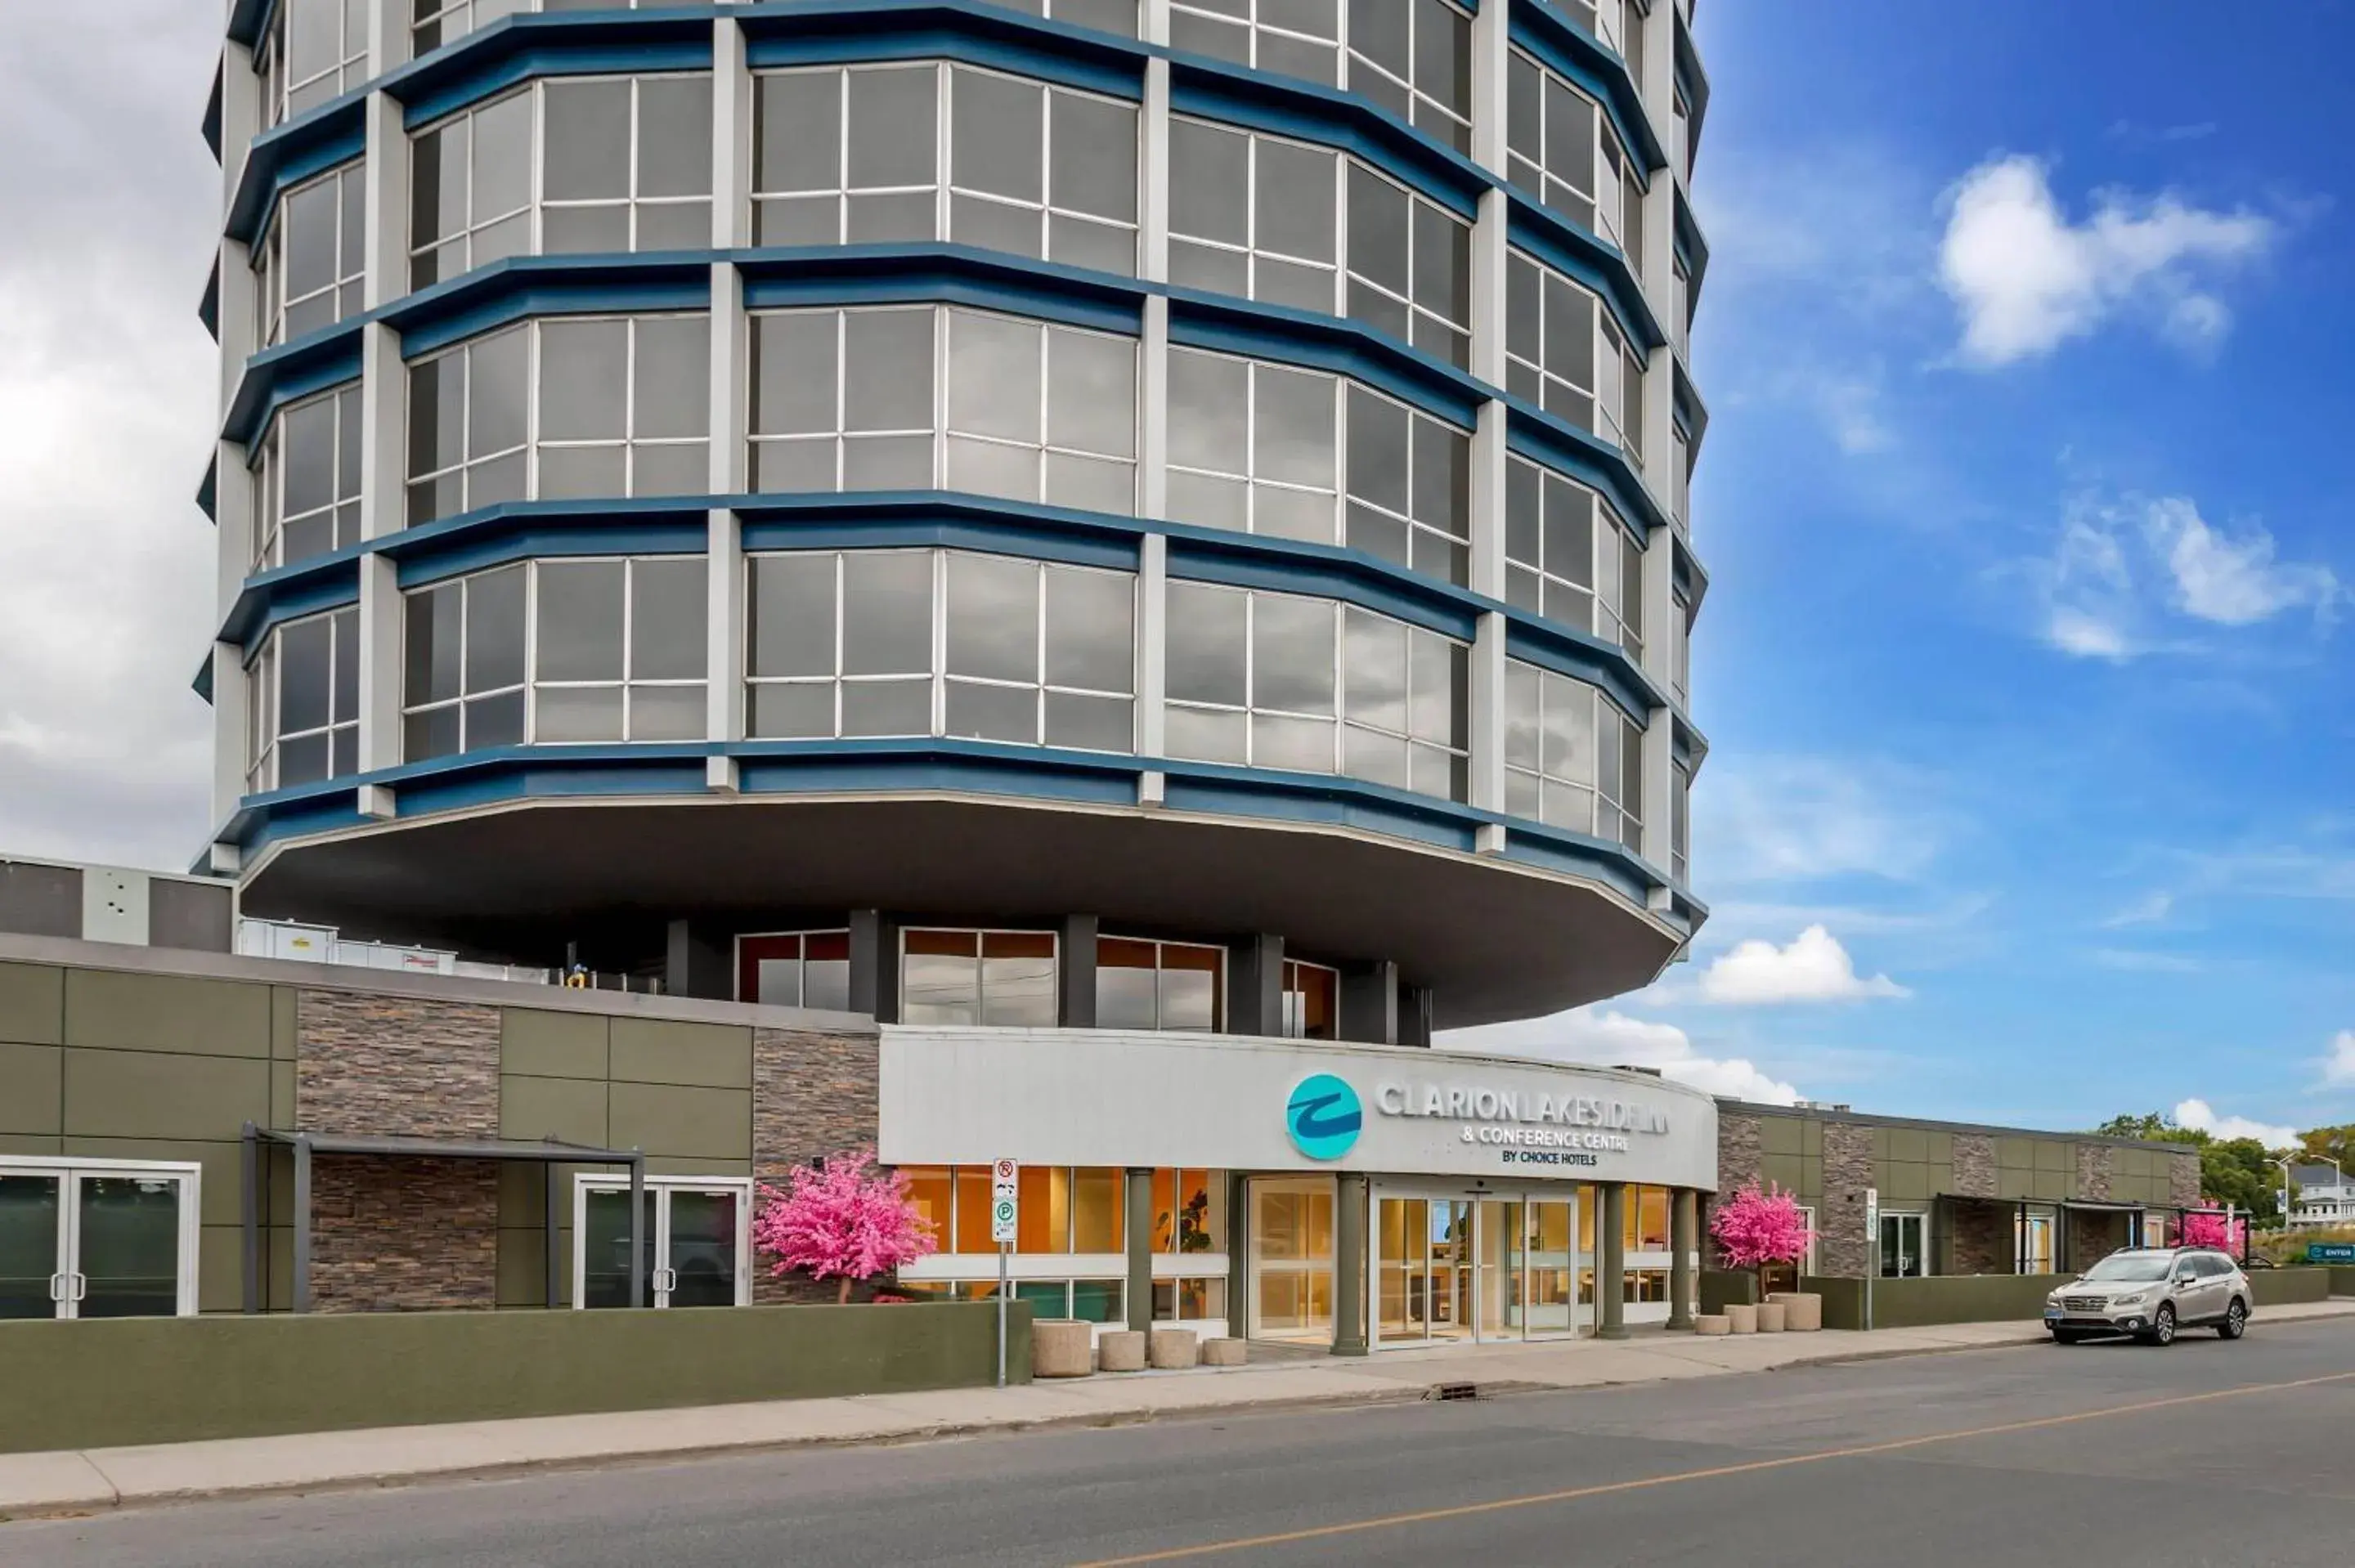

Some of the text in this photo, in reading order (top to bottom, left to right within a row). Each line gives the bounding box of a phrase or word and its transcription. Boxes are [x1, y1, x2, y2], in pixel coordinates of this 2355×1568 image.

[1375, 1082, 1518, 1120] CLARION
[1460, 1124, 1631, 1151] & CONFERENCE CENTRE
[1502, 1149, 1598, 1166] BY CHOICE HOTELS
[2326, 1248, 2352, 1257] ENTER
